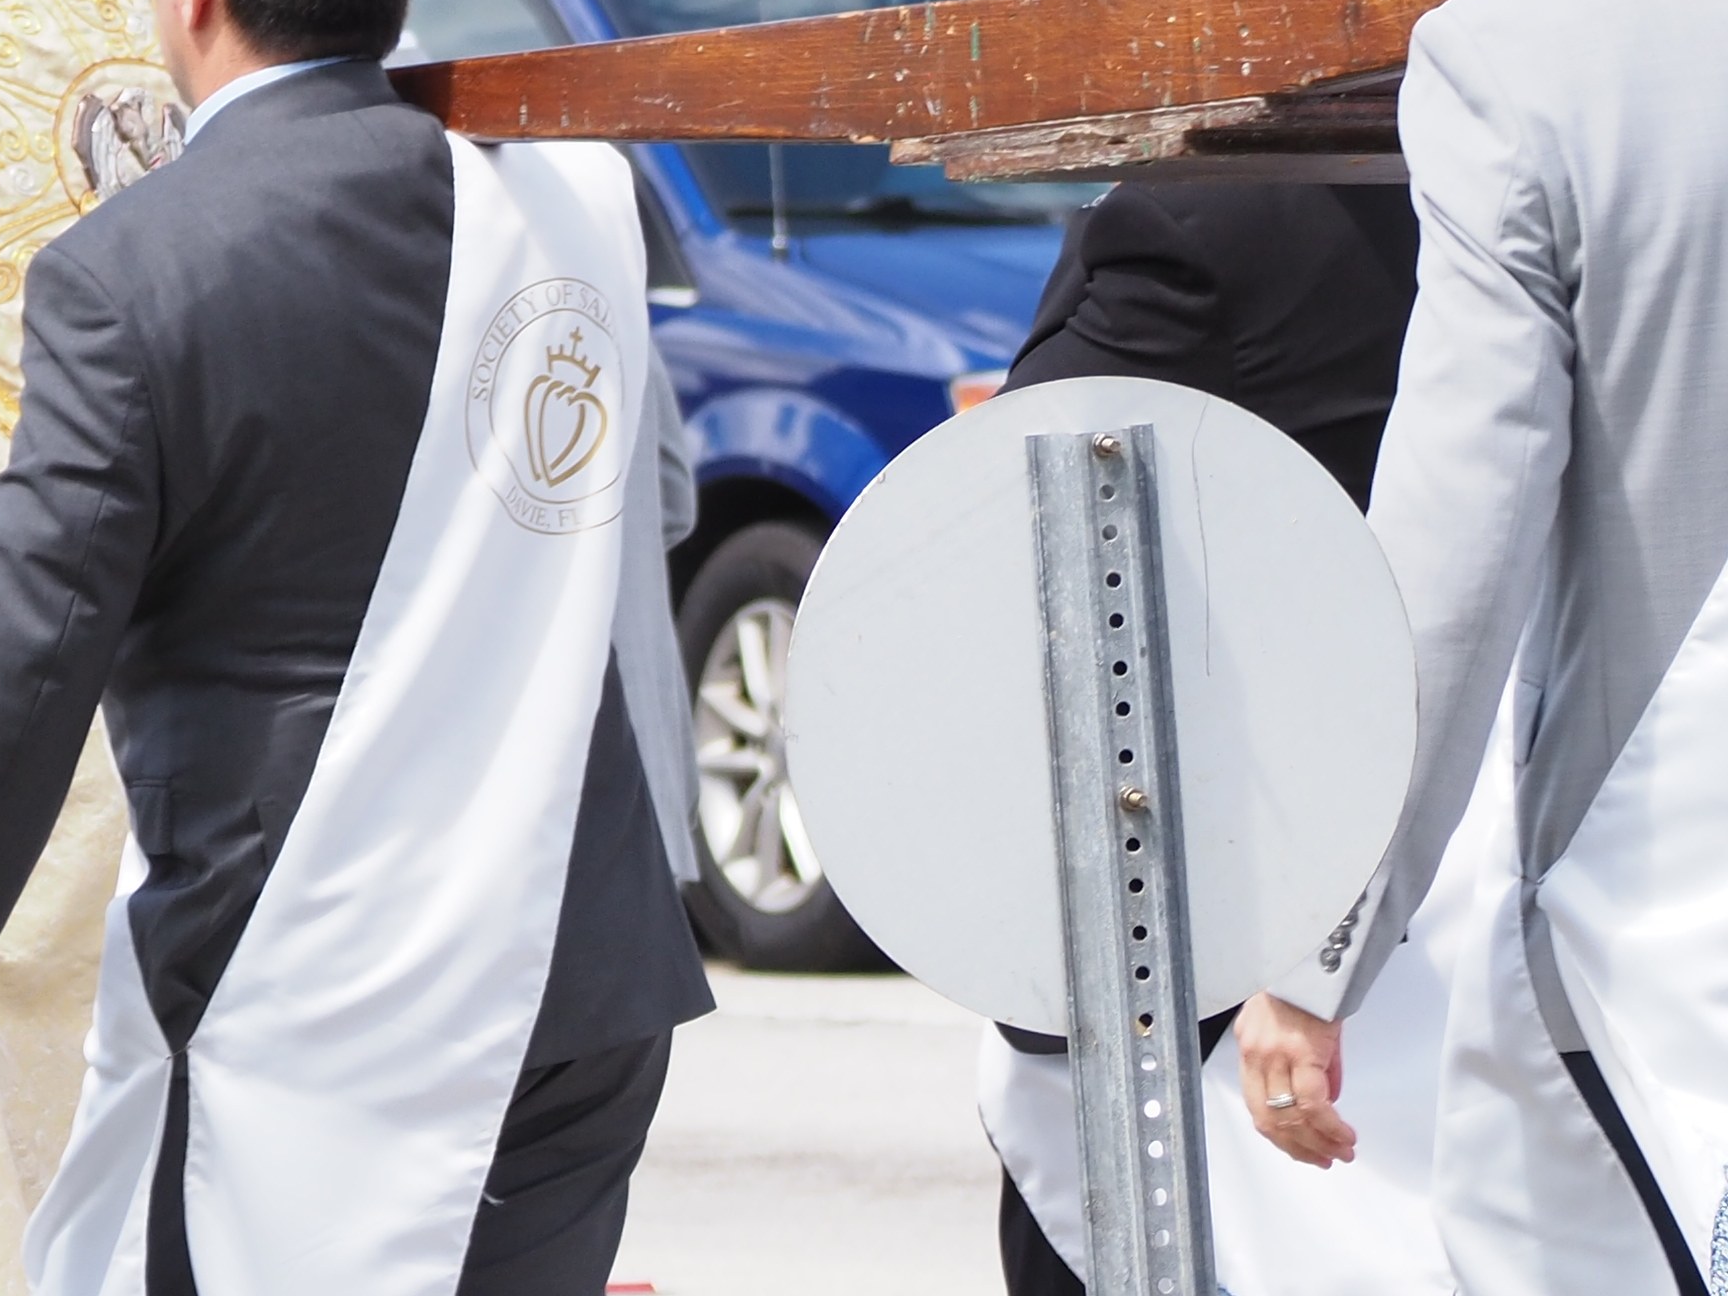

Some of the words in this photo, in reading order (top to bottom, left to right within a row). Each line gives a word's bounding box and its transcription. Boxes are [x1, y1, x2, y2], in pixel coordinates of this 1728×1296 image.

[472, 290, 538, 402] SOCIETY
[545, 283, 573, 307] OF
[504, 485, 551, 530] DAVIE,
[558, 508, 582, 527] FL
